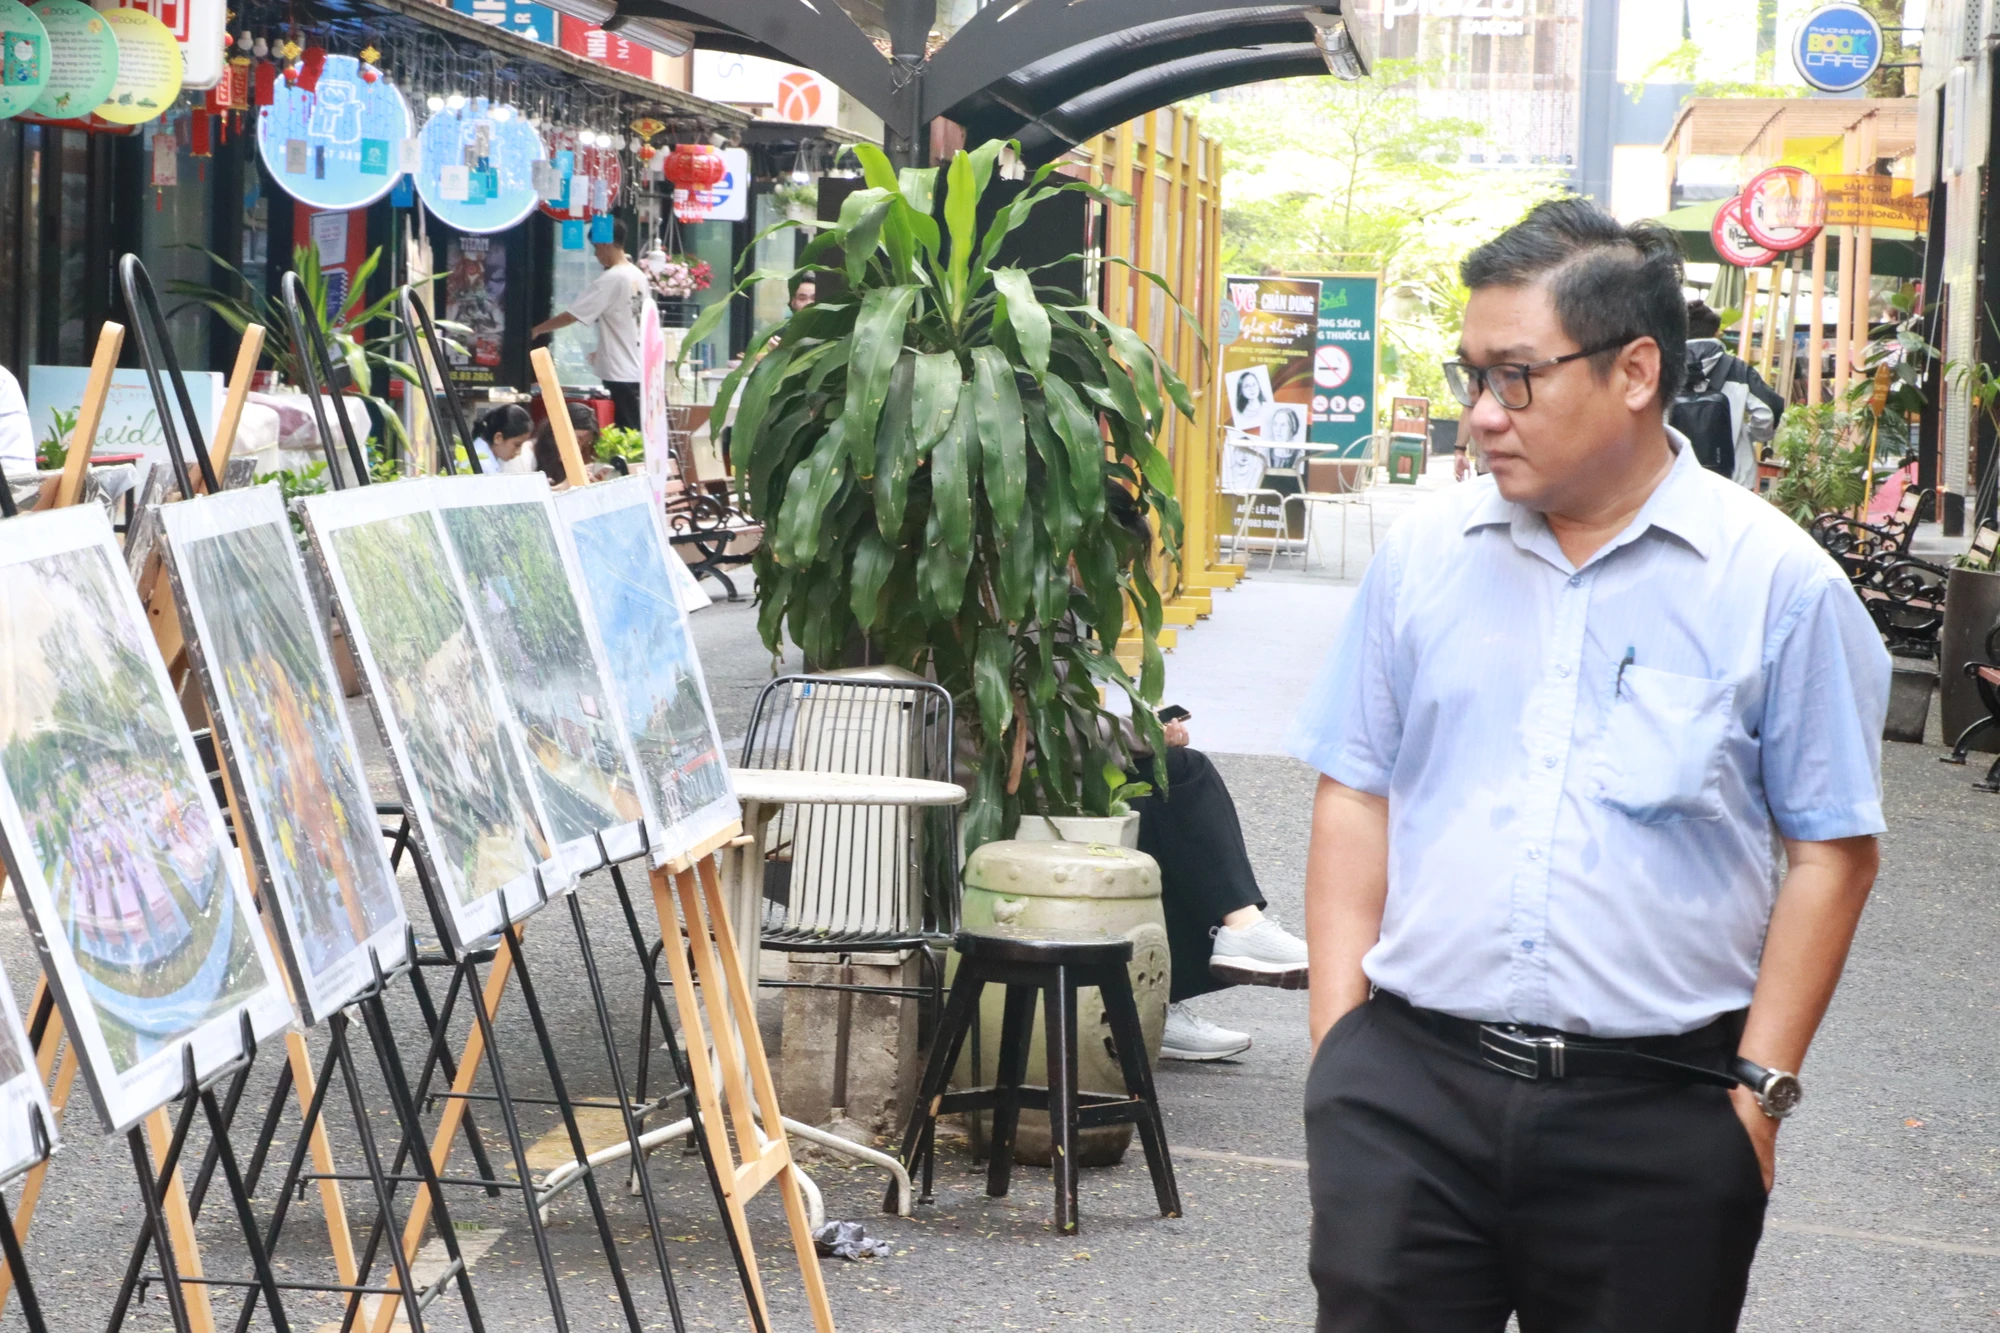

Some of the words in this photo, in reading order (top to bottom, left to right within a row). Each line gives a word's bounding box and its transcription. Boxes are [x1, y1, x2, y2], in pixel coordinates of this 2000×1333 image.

[1807, 33, 1870, 55] BOOK
[1806, 52, 1869, 69] CAFE
[1867, 210, 1904, 221] HONDA
